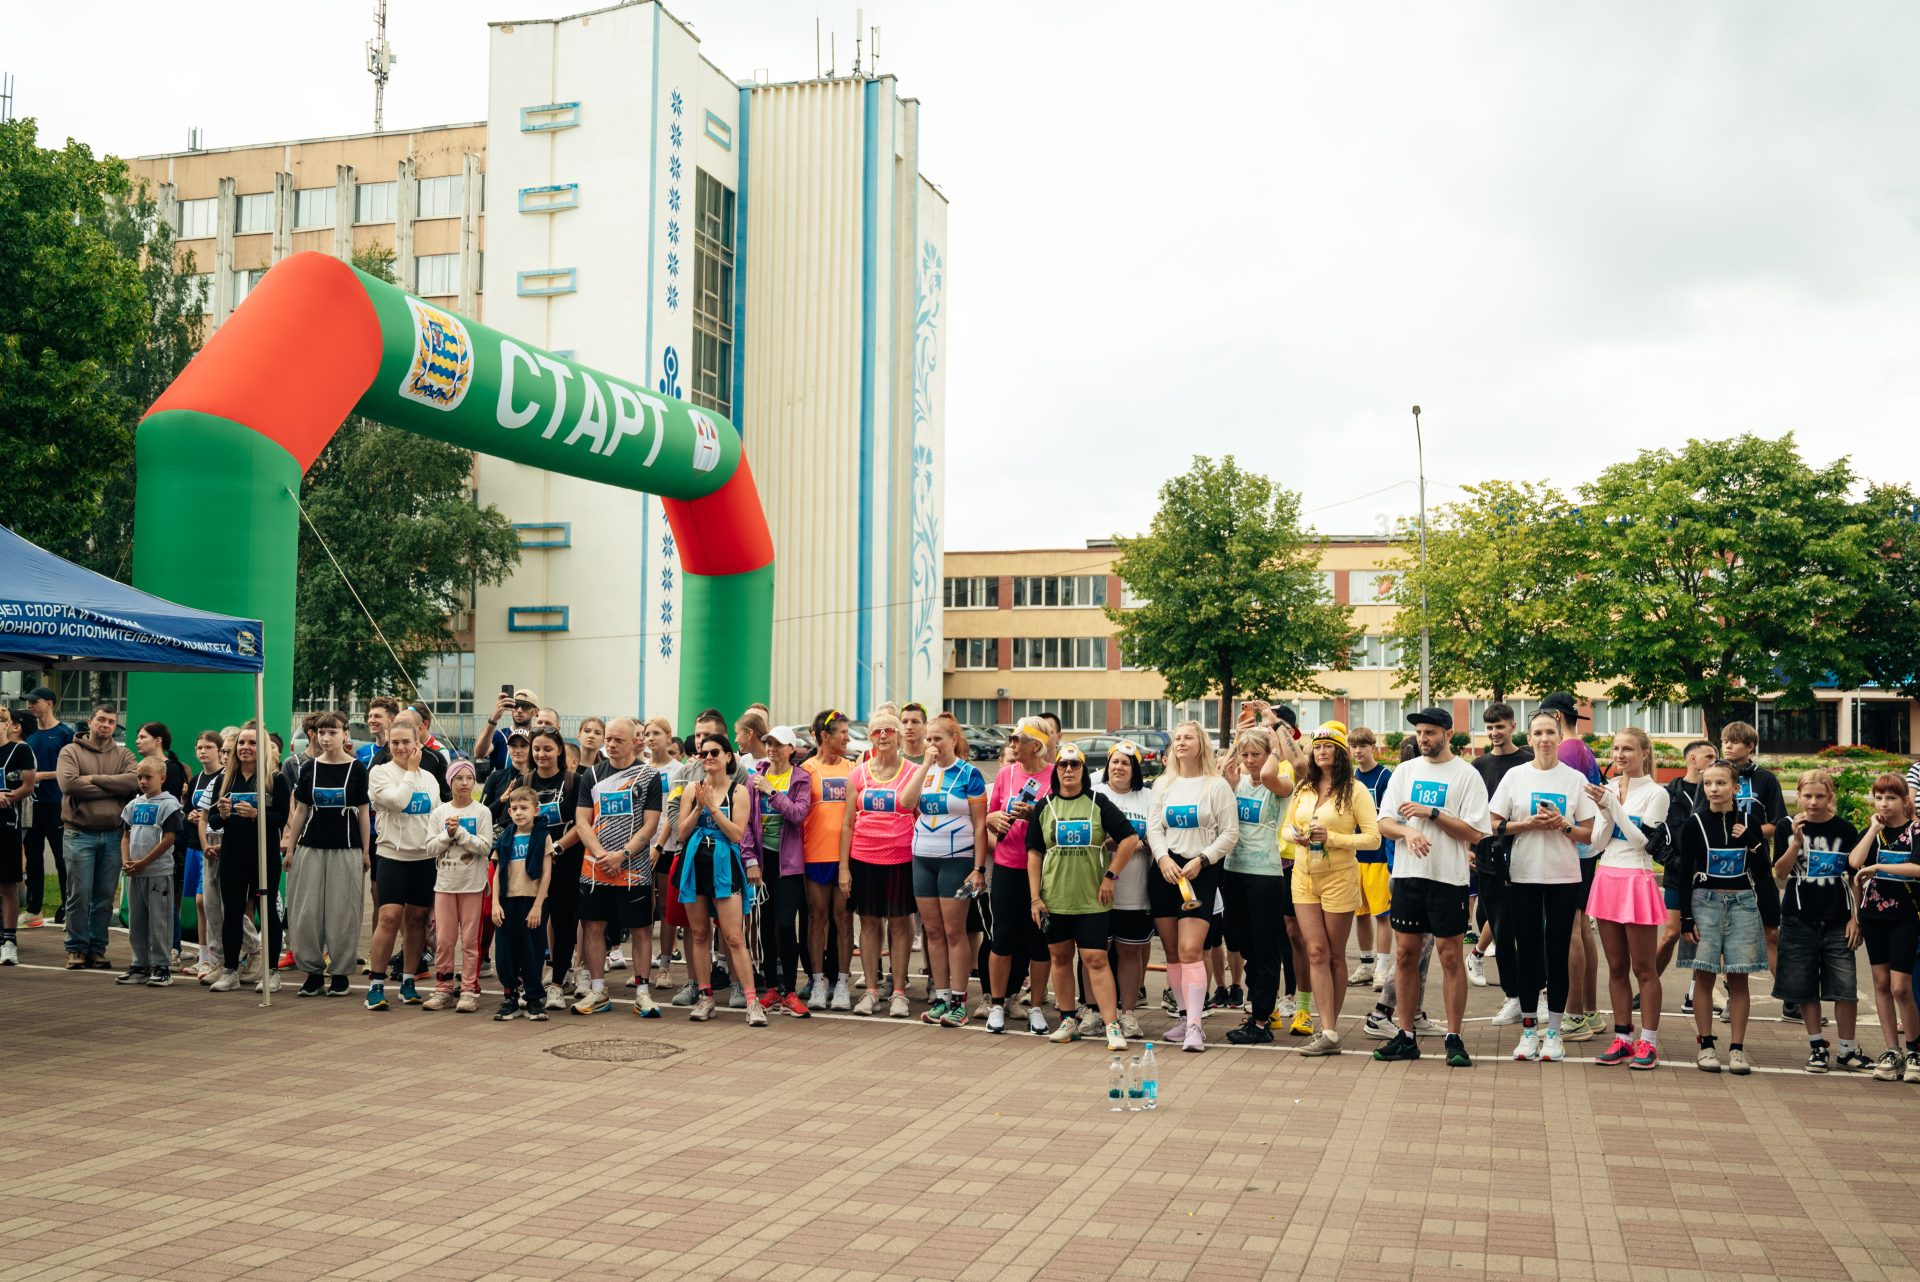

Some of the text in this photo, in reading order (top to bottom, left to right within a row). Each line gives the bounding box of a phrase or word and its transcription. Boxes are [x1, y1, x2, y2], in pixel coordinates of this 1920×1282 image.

[496, 340, 669, 468] СТАРТ
[25, 604, 76, 619] СПОРТА
[60, 622, 182, 647] ИСПОЛНИТЕЛЬНОГО
[829, 786, 846, 800] 196
[1418, 789, 1438, 804] 183
[411, 800, 423, 813] 67
[606, 800, 624, 813] 161
[872, 797, 885, 810] 96
[926, 802, 939, 814] 93
[1175, 814, 1189, 827] 61
[1067, 830, 1081, 844] 85
[1720, 860, 1735, 874] 24
